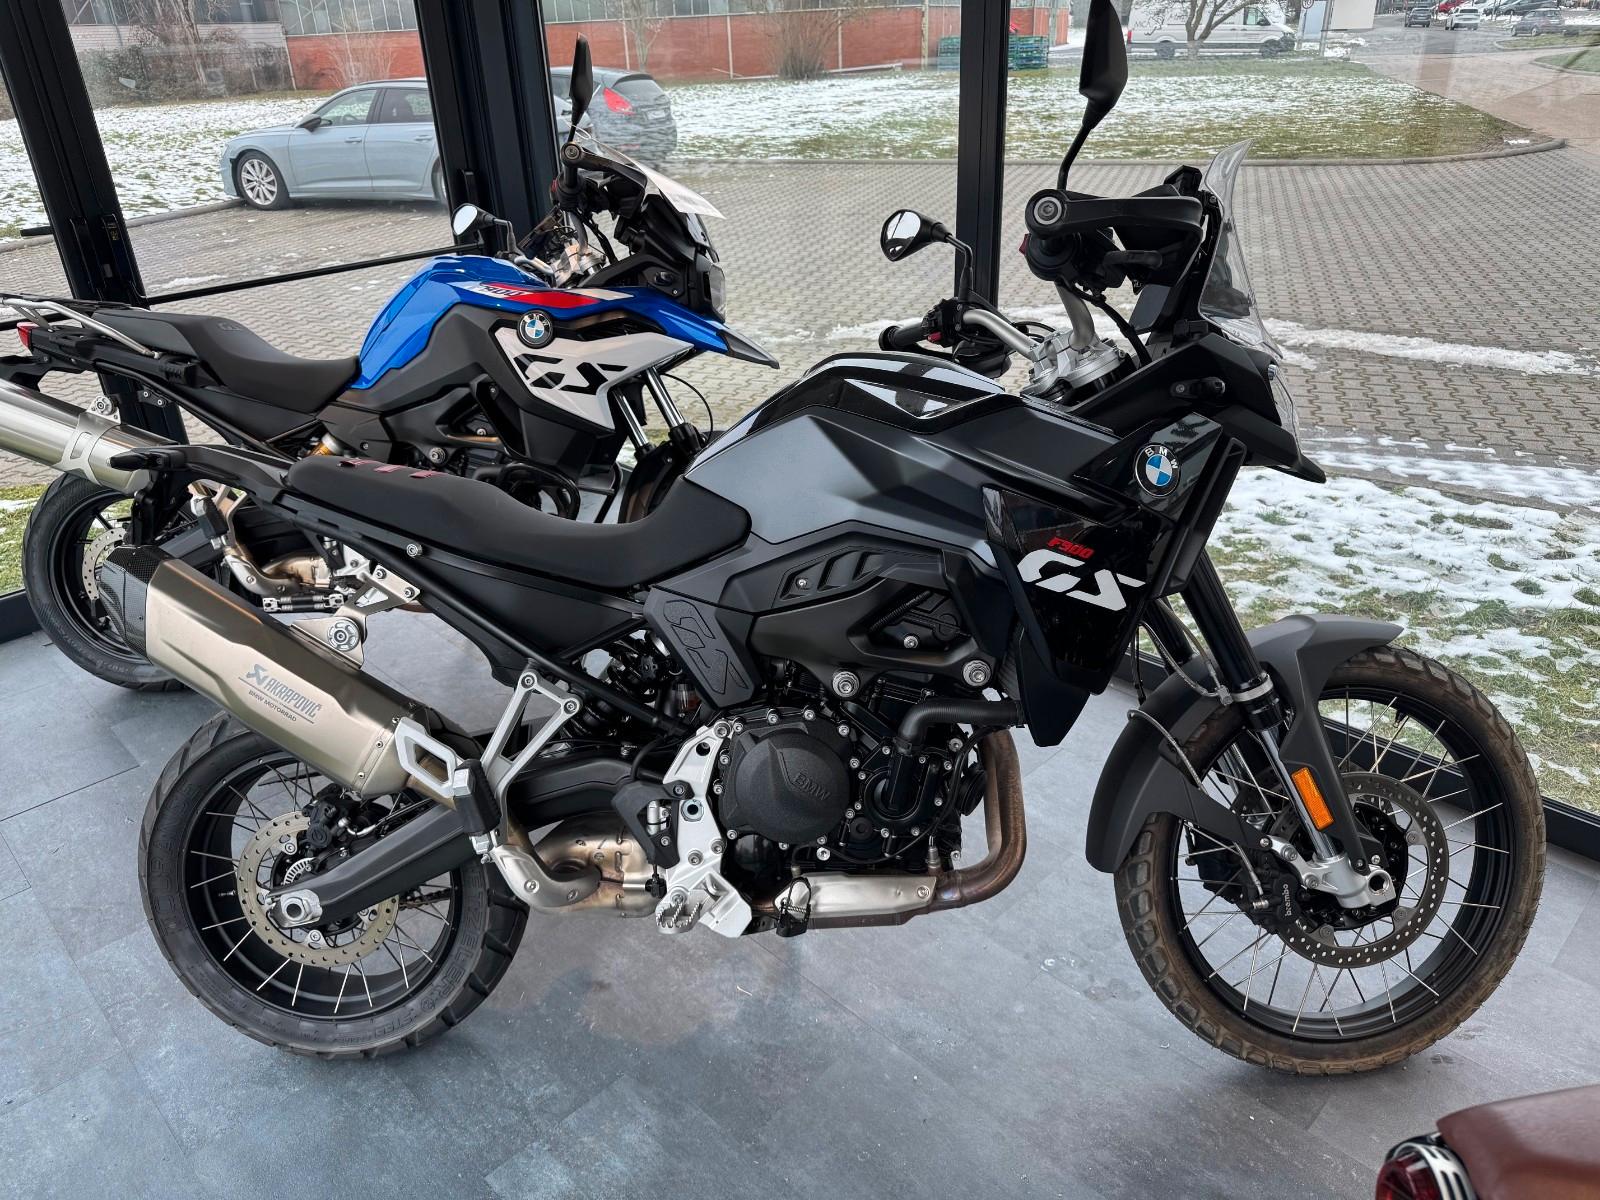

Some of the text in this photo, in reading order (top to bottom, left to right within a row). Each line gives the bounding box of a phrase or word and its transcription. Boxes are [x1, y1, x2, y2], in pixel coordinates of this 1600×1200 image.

[1144, 446, 1179, 470] BMW
[248, 690, 297, 722] BMW MOTORRAD
[794, 773, 831, 800] BMW
[1282, 883, 1292, 917] brembo
